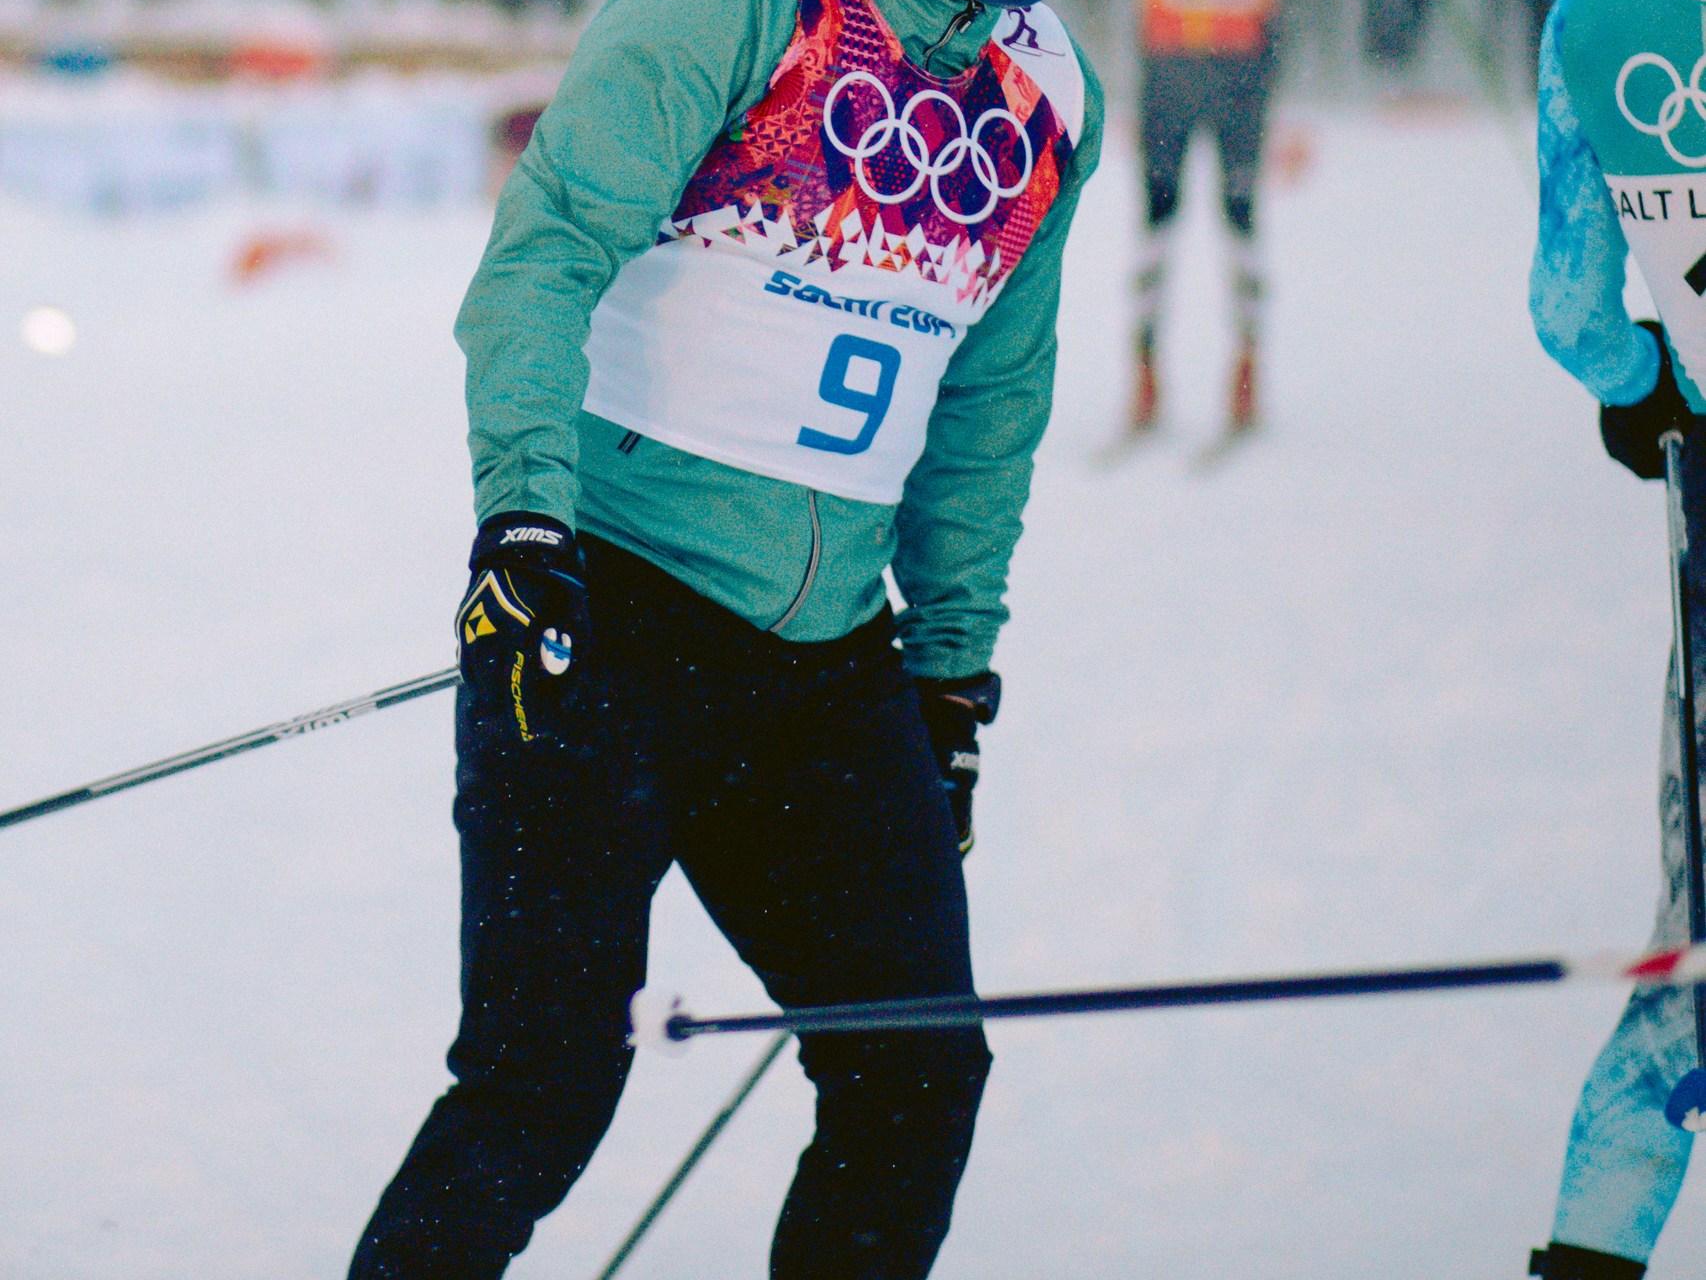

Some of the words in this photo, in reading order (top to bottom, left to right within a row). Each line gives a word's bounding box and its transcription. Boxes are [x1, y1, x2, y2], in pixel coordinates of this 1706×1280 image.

[1610, 188, 1672, 221] ALT
[797, 333, 902, 455] 9
[511, 650, 529, 733] FISCHER
